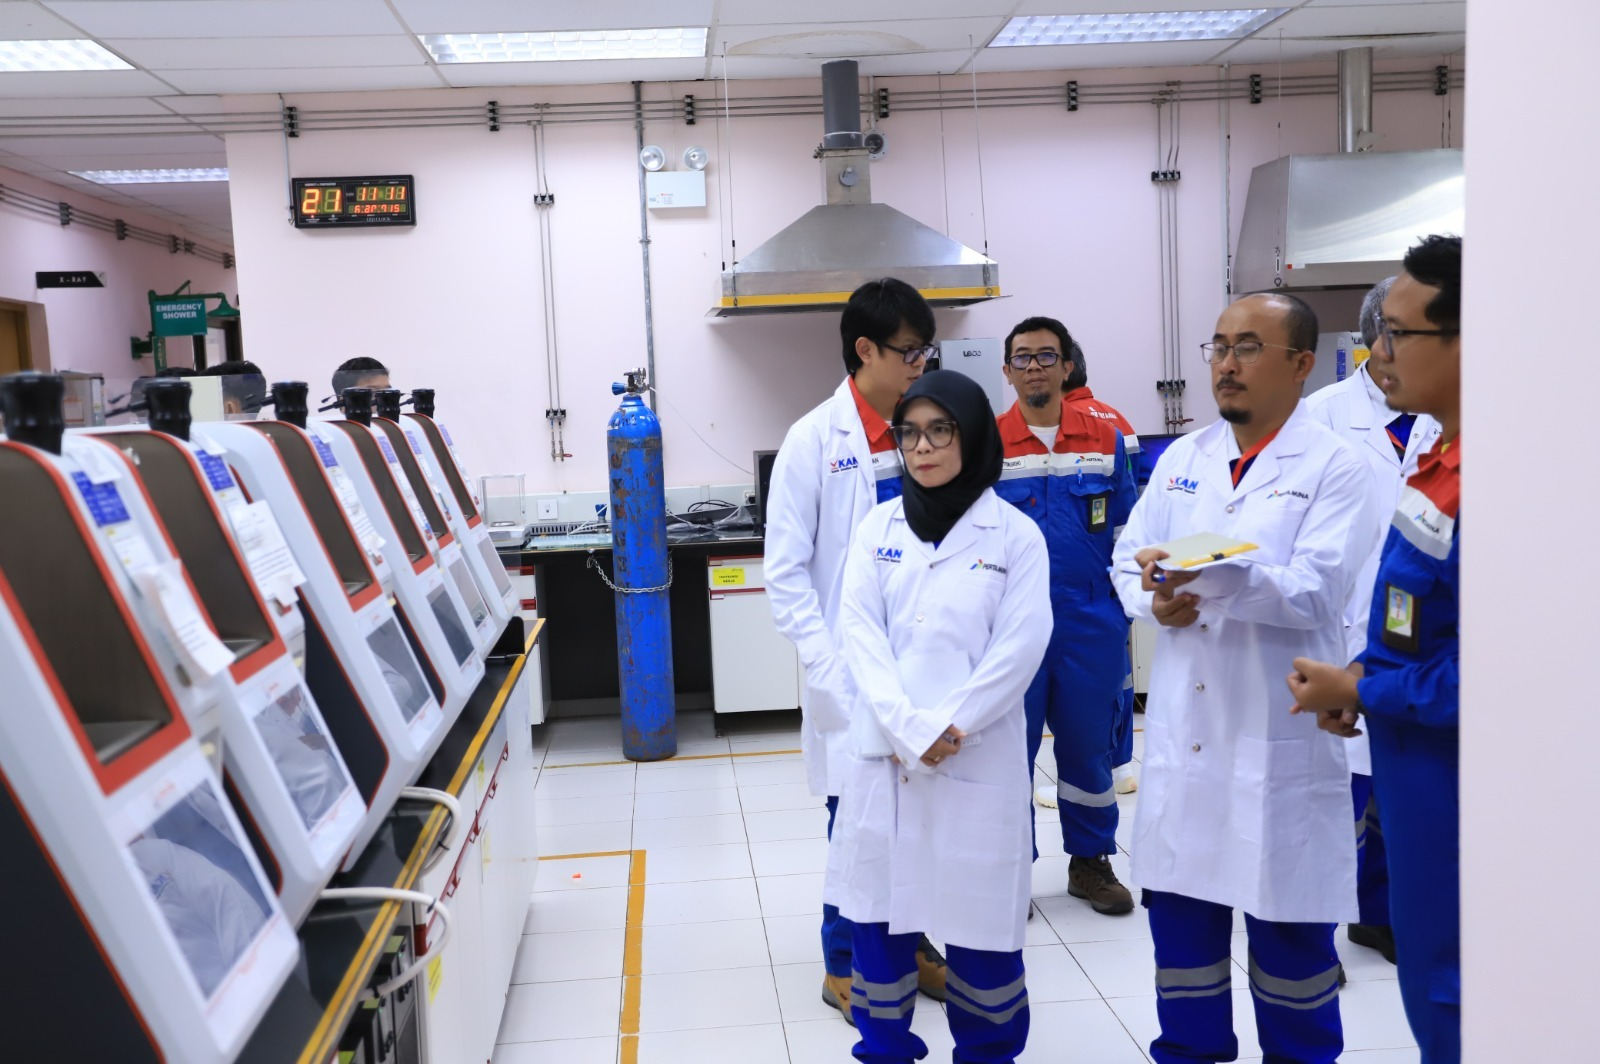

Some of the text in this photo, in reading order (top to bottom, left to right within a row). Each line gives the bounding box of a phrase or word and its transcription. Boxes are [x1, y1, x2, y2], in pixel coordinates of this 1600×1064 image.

[156, 303, 201, 312] EMERGENCY
[162, 311, 197, 320] SHOWER
[1175, 476, 1199, 490] KAN
[877, 547, 902, 558] KAN
